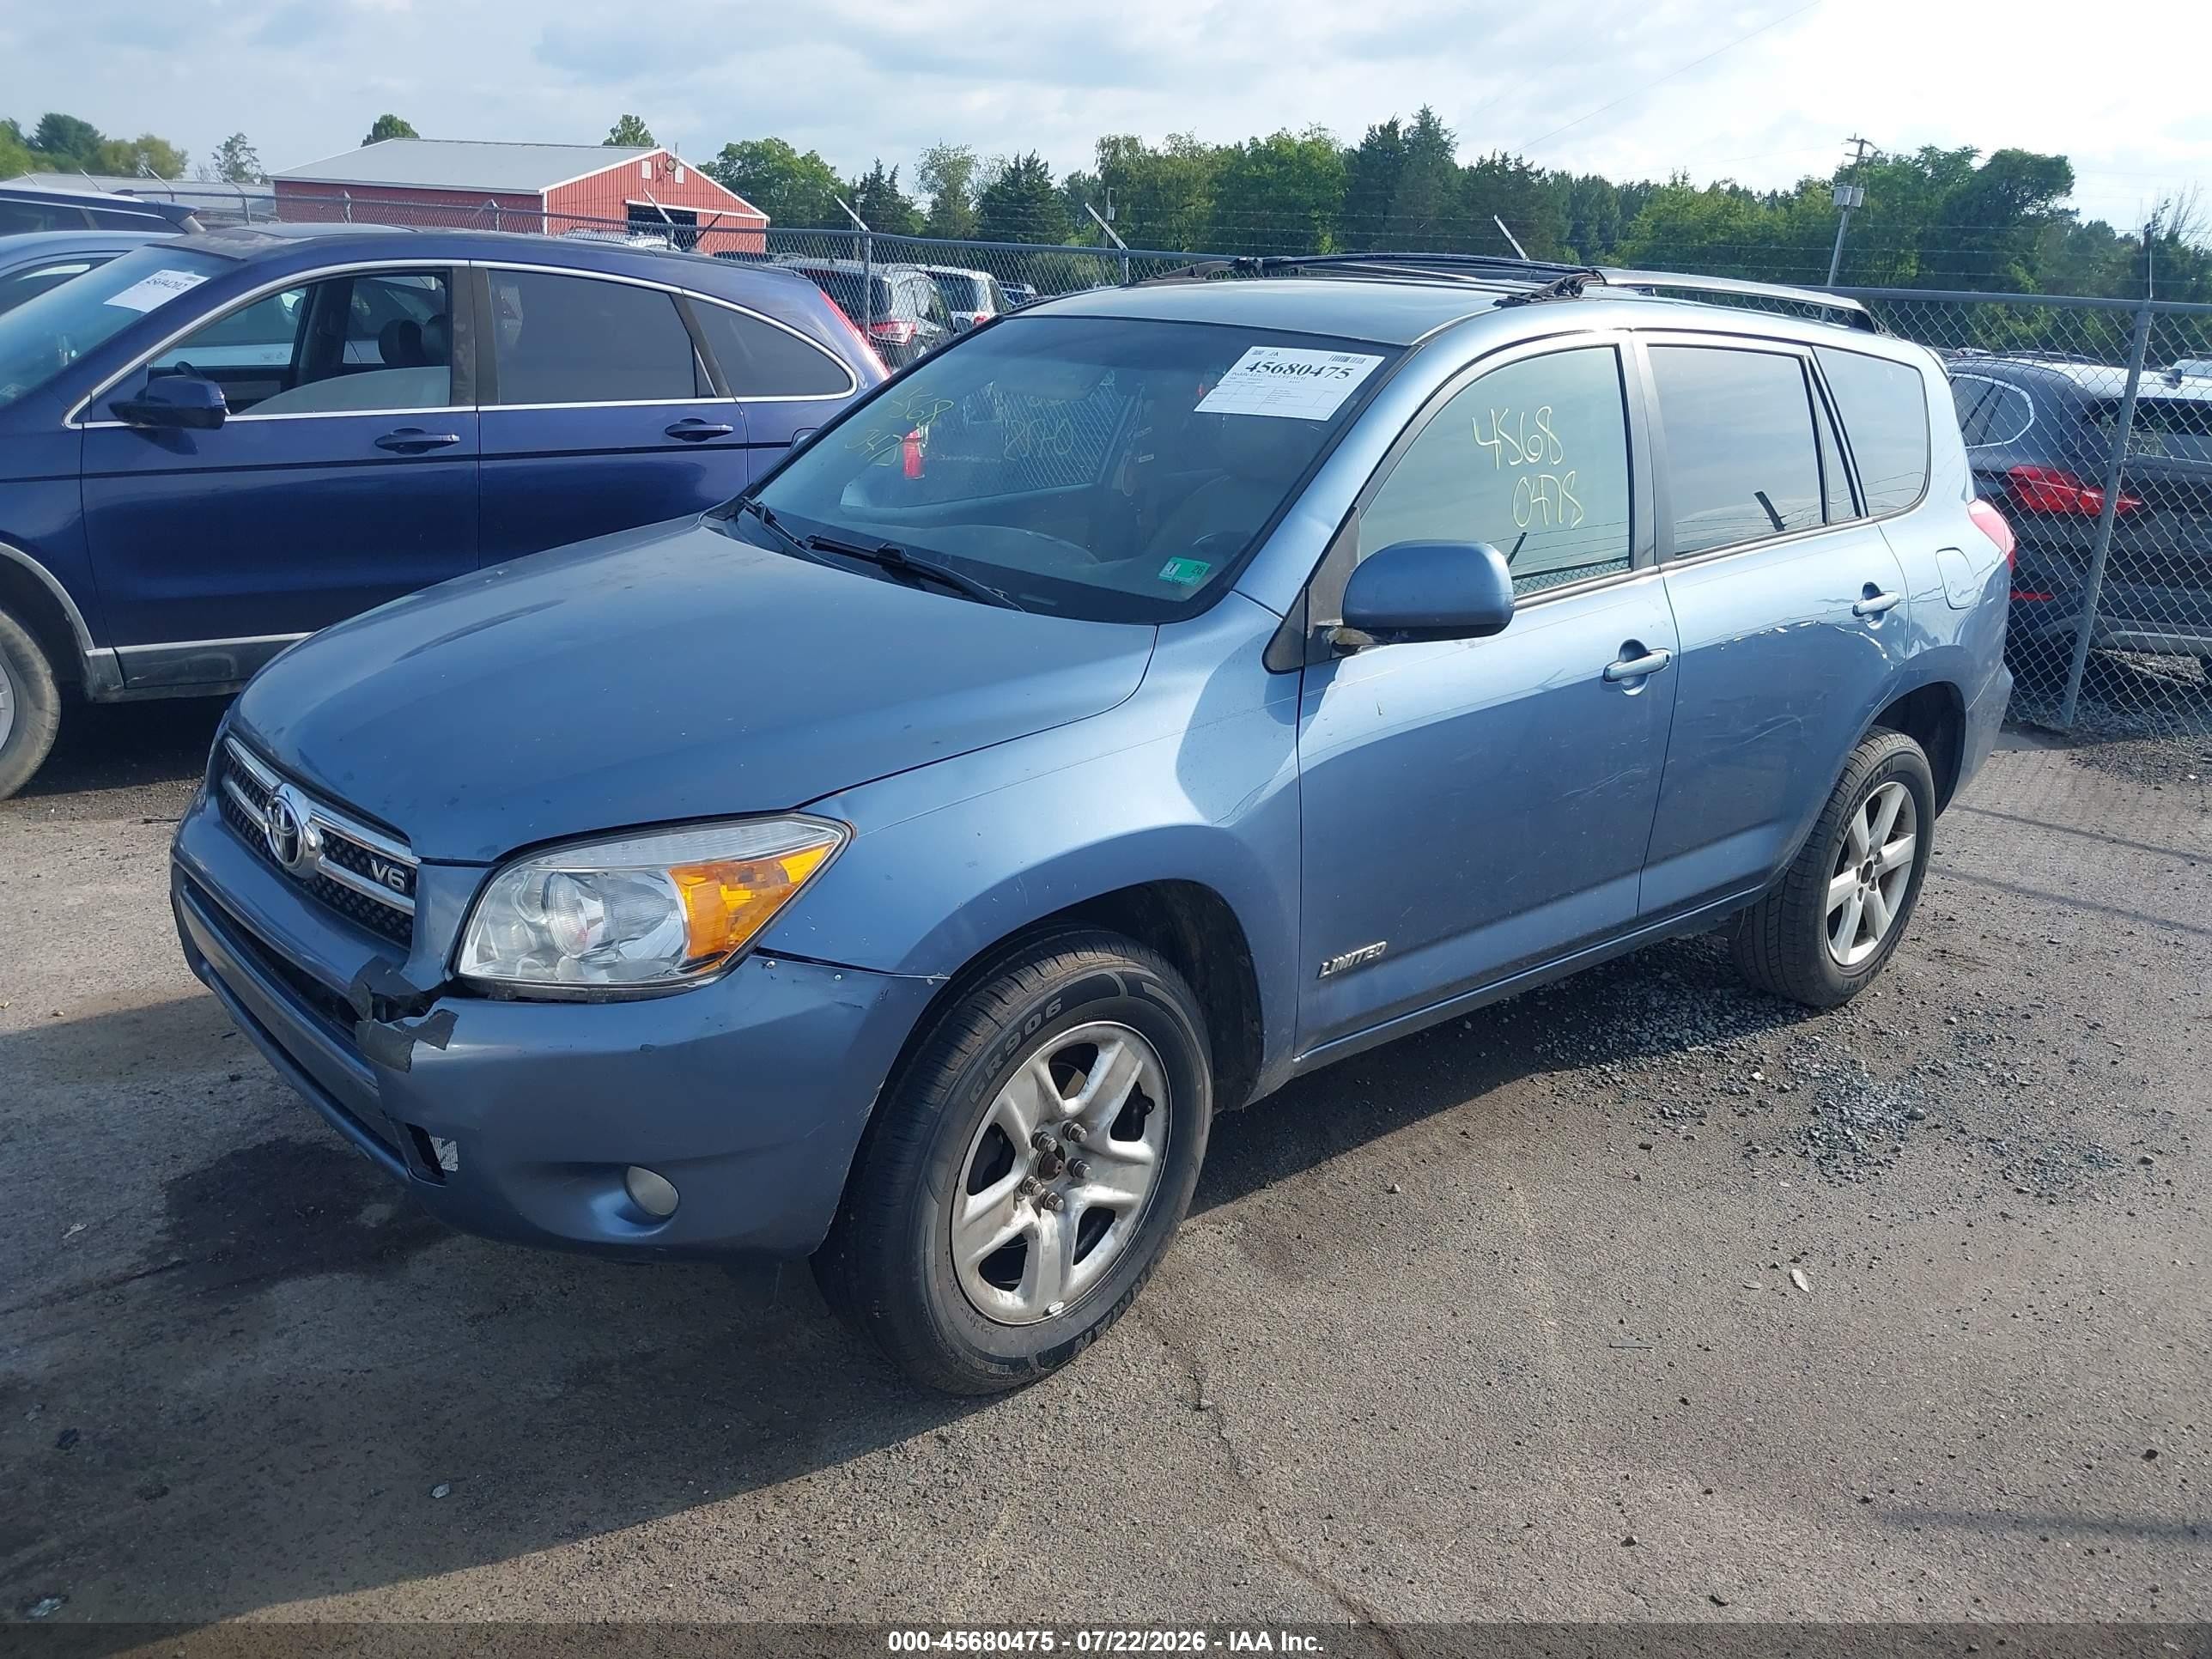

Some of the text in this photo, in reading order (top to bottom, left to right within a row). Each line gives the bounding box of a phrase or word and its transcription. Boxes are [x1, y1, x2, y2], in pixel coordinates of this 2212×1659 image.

[1244, 360, 1357, 380] 45680475
[1472, 405, 1564, 471] 4568
[370, 859, 406, 893] V6
[1316, 940, 1388, 979] LIMITED
[968, 996, 1063, 1104] GR906
